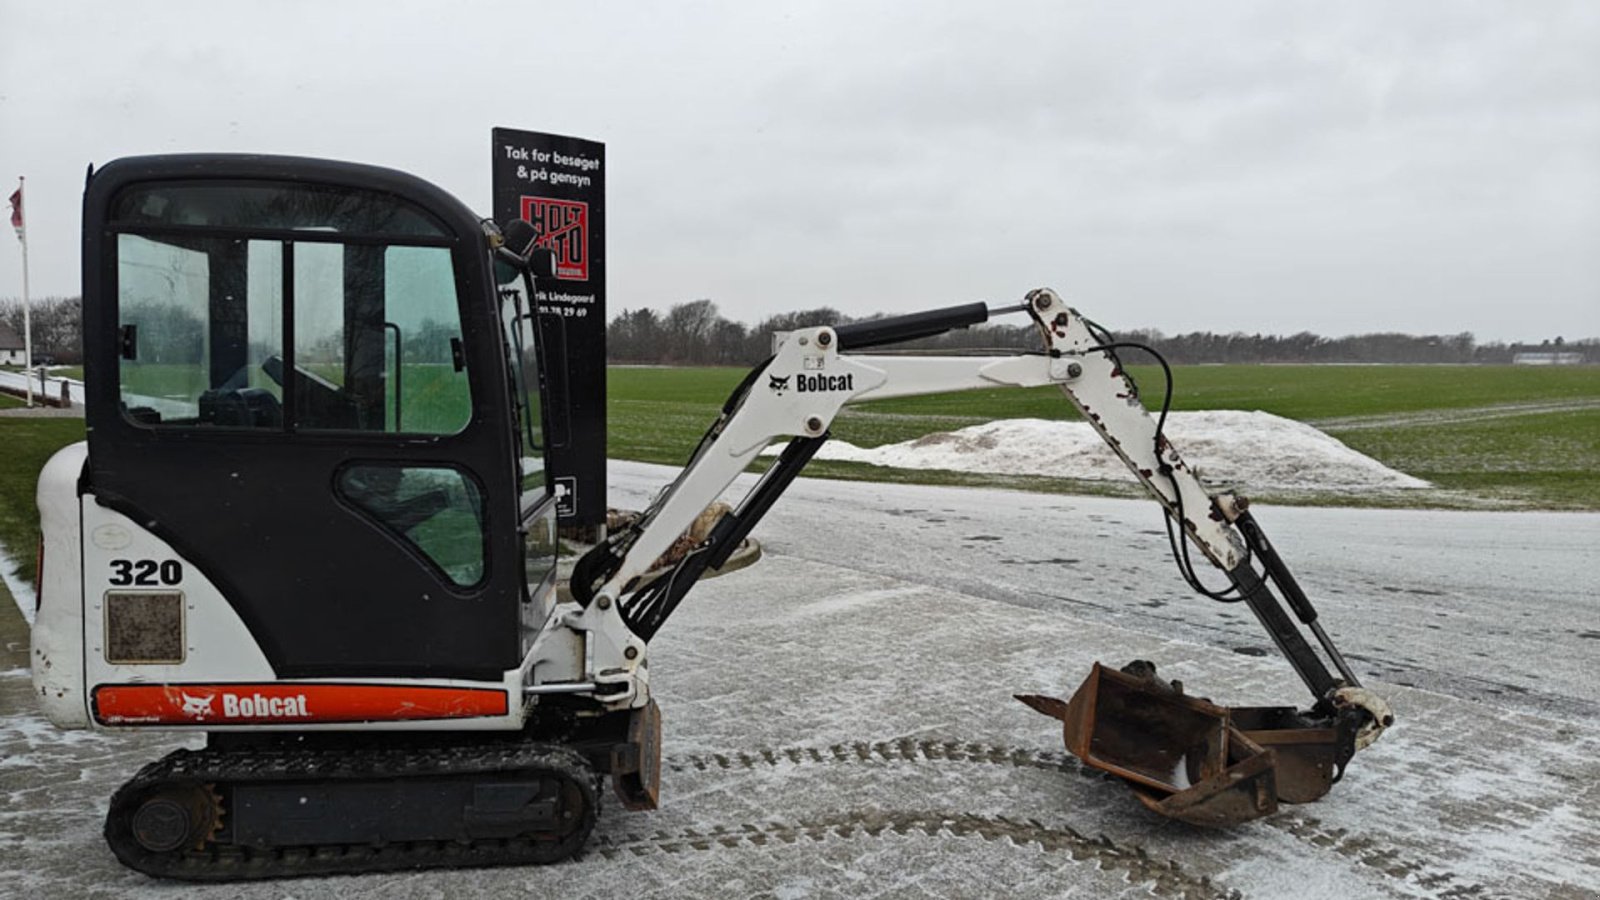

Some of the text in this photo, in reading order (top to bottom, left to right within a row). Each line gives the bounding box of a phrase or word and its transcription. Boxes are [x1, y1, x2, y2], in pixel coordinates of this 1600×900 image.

[505, 145, 600, 171] Tak for besøget
[517, 165, 591, 188] & på gensyn
[530, 202, 583, 237] HOLT
[549, 291, 595, 304] Lindegaard
[563, 307, 575, 317] 29
[576, 307, 588, 317] 69
[796, 373, 853, 393] Bobcat
[109, 559, 183, 586] 320
[222, 693, 309, 718] Bobcat
